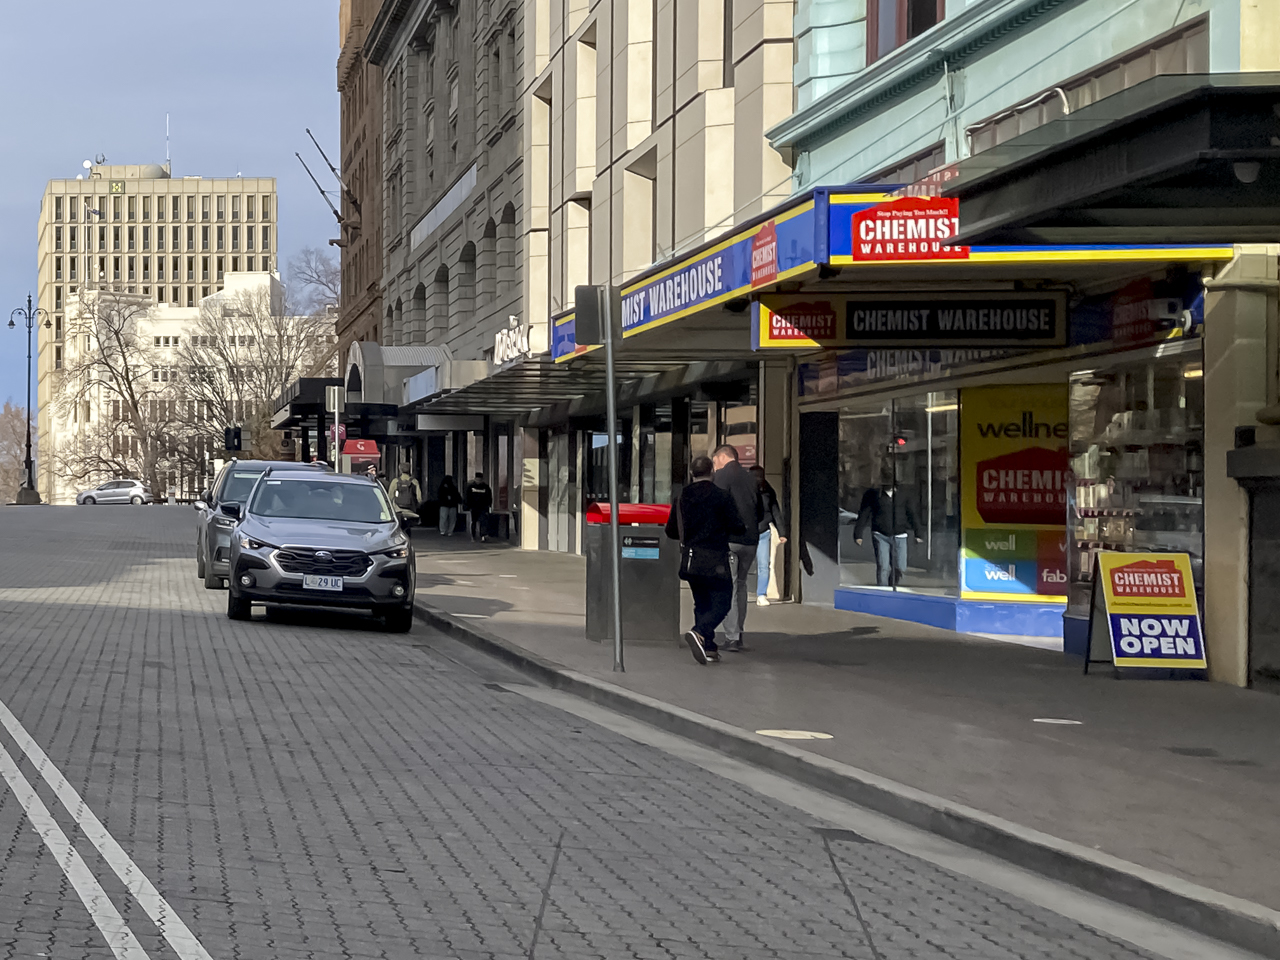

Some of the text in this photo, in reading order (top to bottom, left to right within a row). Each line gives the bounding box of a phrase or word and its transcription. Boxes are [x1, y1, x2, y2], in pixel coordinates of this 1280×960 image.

[860, 217, 959, 241] CHEMIST
[753, 241, 776, 269] CHEMIST
[649, 257, 723, 317] WAREHOUSE
[773, 314, 833, 328] CHEMIST
[853, 308, 1050, 331] CHEMIST WAREHOUSE
[773, 328, 832, 336] WAREHOUSE
[985, 534, 1016, 551] well
[985, 564, 1016, 581] well
[1042, 568, 1068, 582] fab
[1114, 572, 1180, 586] CHEMIST
[1115, 585, 1181, 594] WAREHOUSE
[1120, 618, 1190, 637] NOW
[1120, 636, 1196, 655] OPEN
